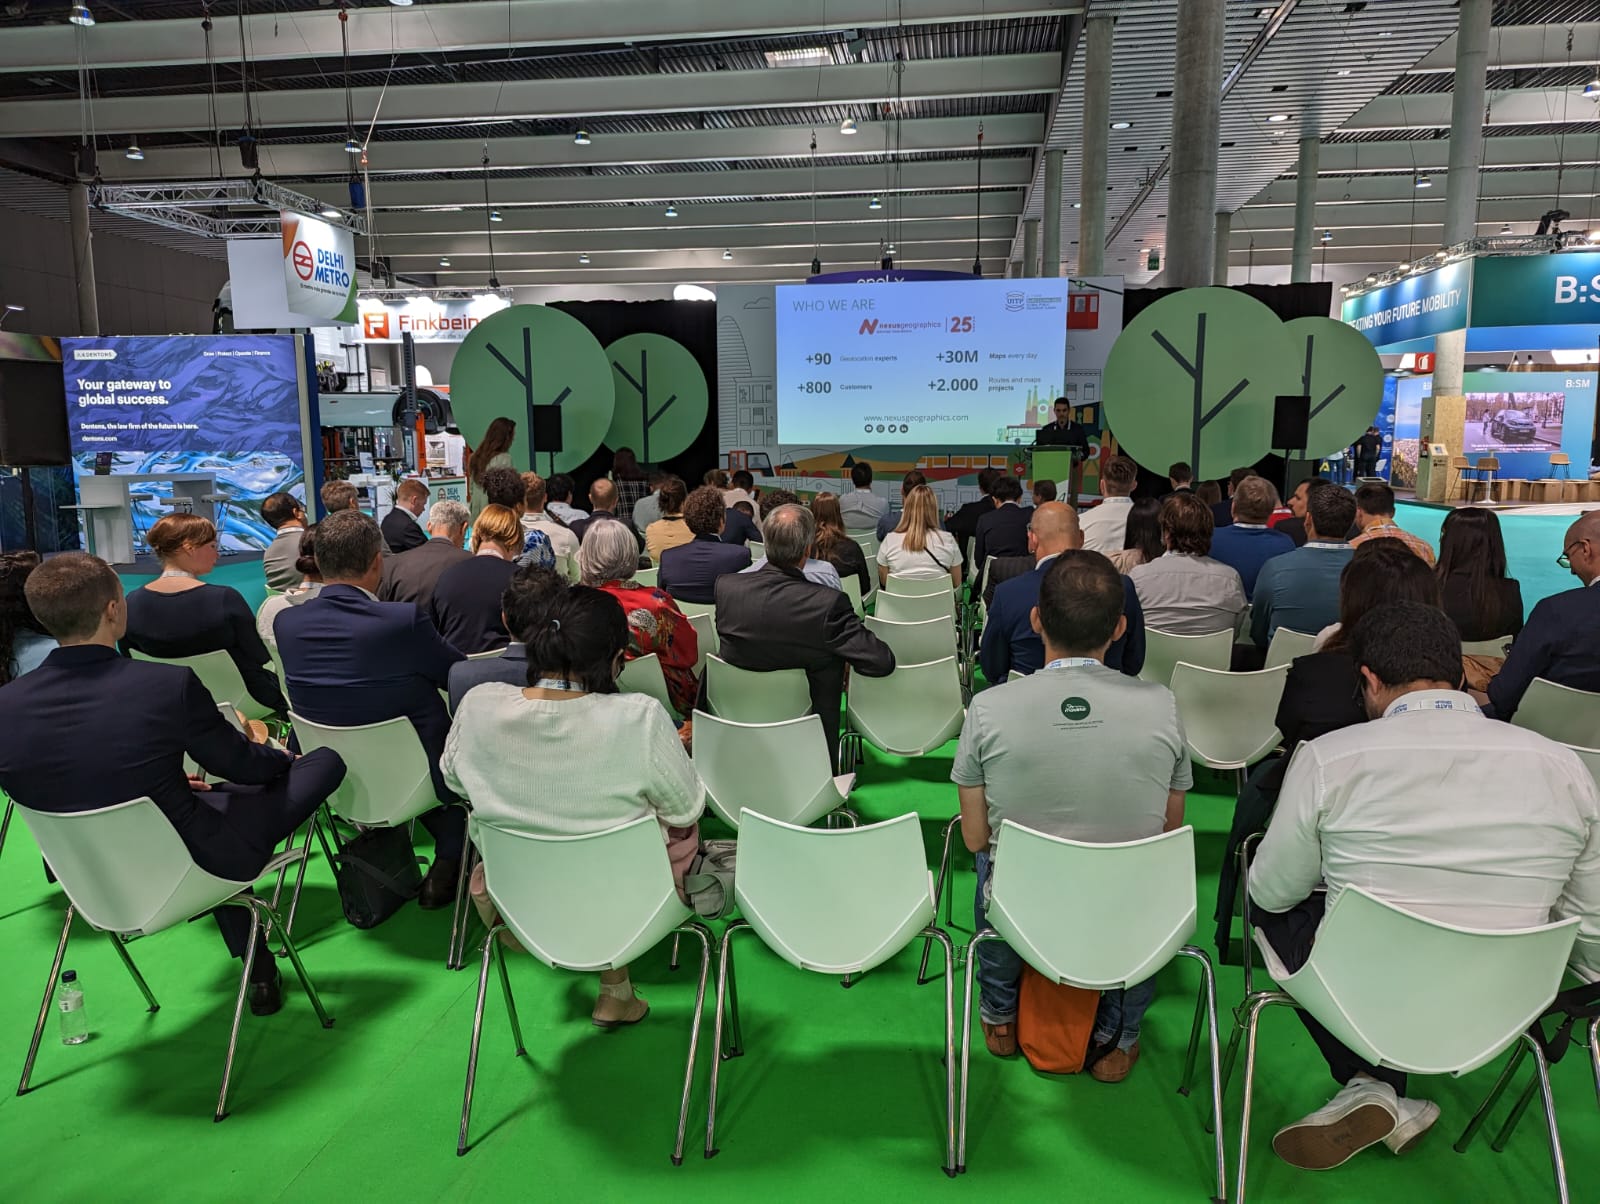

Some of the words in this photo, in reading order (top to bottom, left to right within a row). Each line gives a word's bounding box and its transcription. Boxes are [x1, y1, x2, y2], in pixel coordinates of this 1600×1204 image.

[317, 248, 344, 270] DELHI
[315, 265, 350, 288] METRO
[793, 301, 825, 312] WHO
[828, 300, 848, 311] WE
[852, 299, 876, 310] ARE
[1373, 309, 1392, 327] YOUR
[1392, 300, 1422, 322] FUTURE
[1422, 288, 1462, 313] MOBILITY
[879, 320, 942, 331] nexusgeographics
[950, 315, 972, 333] 25
[805, 352, 832, 365] +90
[936, 350, 979, 363] +30M
[989, 352, 1006, 360] Maps
[1025, 352, 1038, 360] day
[77, 379, 104, 390] Your
[107, 380, 156, 392] gateway
[159, 380, 171, 390] to
[797, 381, 832, 394] +800
[928, 378, 979, 391] +2.000
[988, 385, 1014, 393] projects
[1565, 379, 1590, 388] B:SM
[79, 394, 115, 407] global
[118, 396, 169, 405] success.
[863, 414, 969, 424] www.nexusgeographics.com
